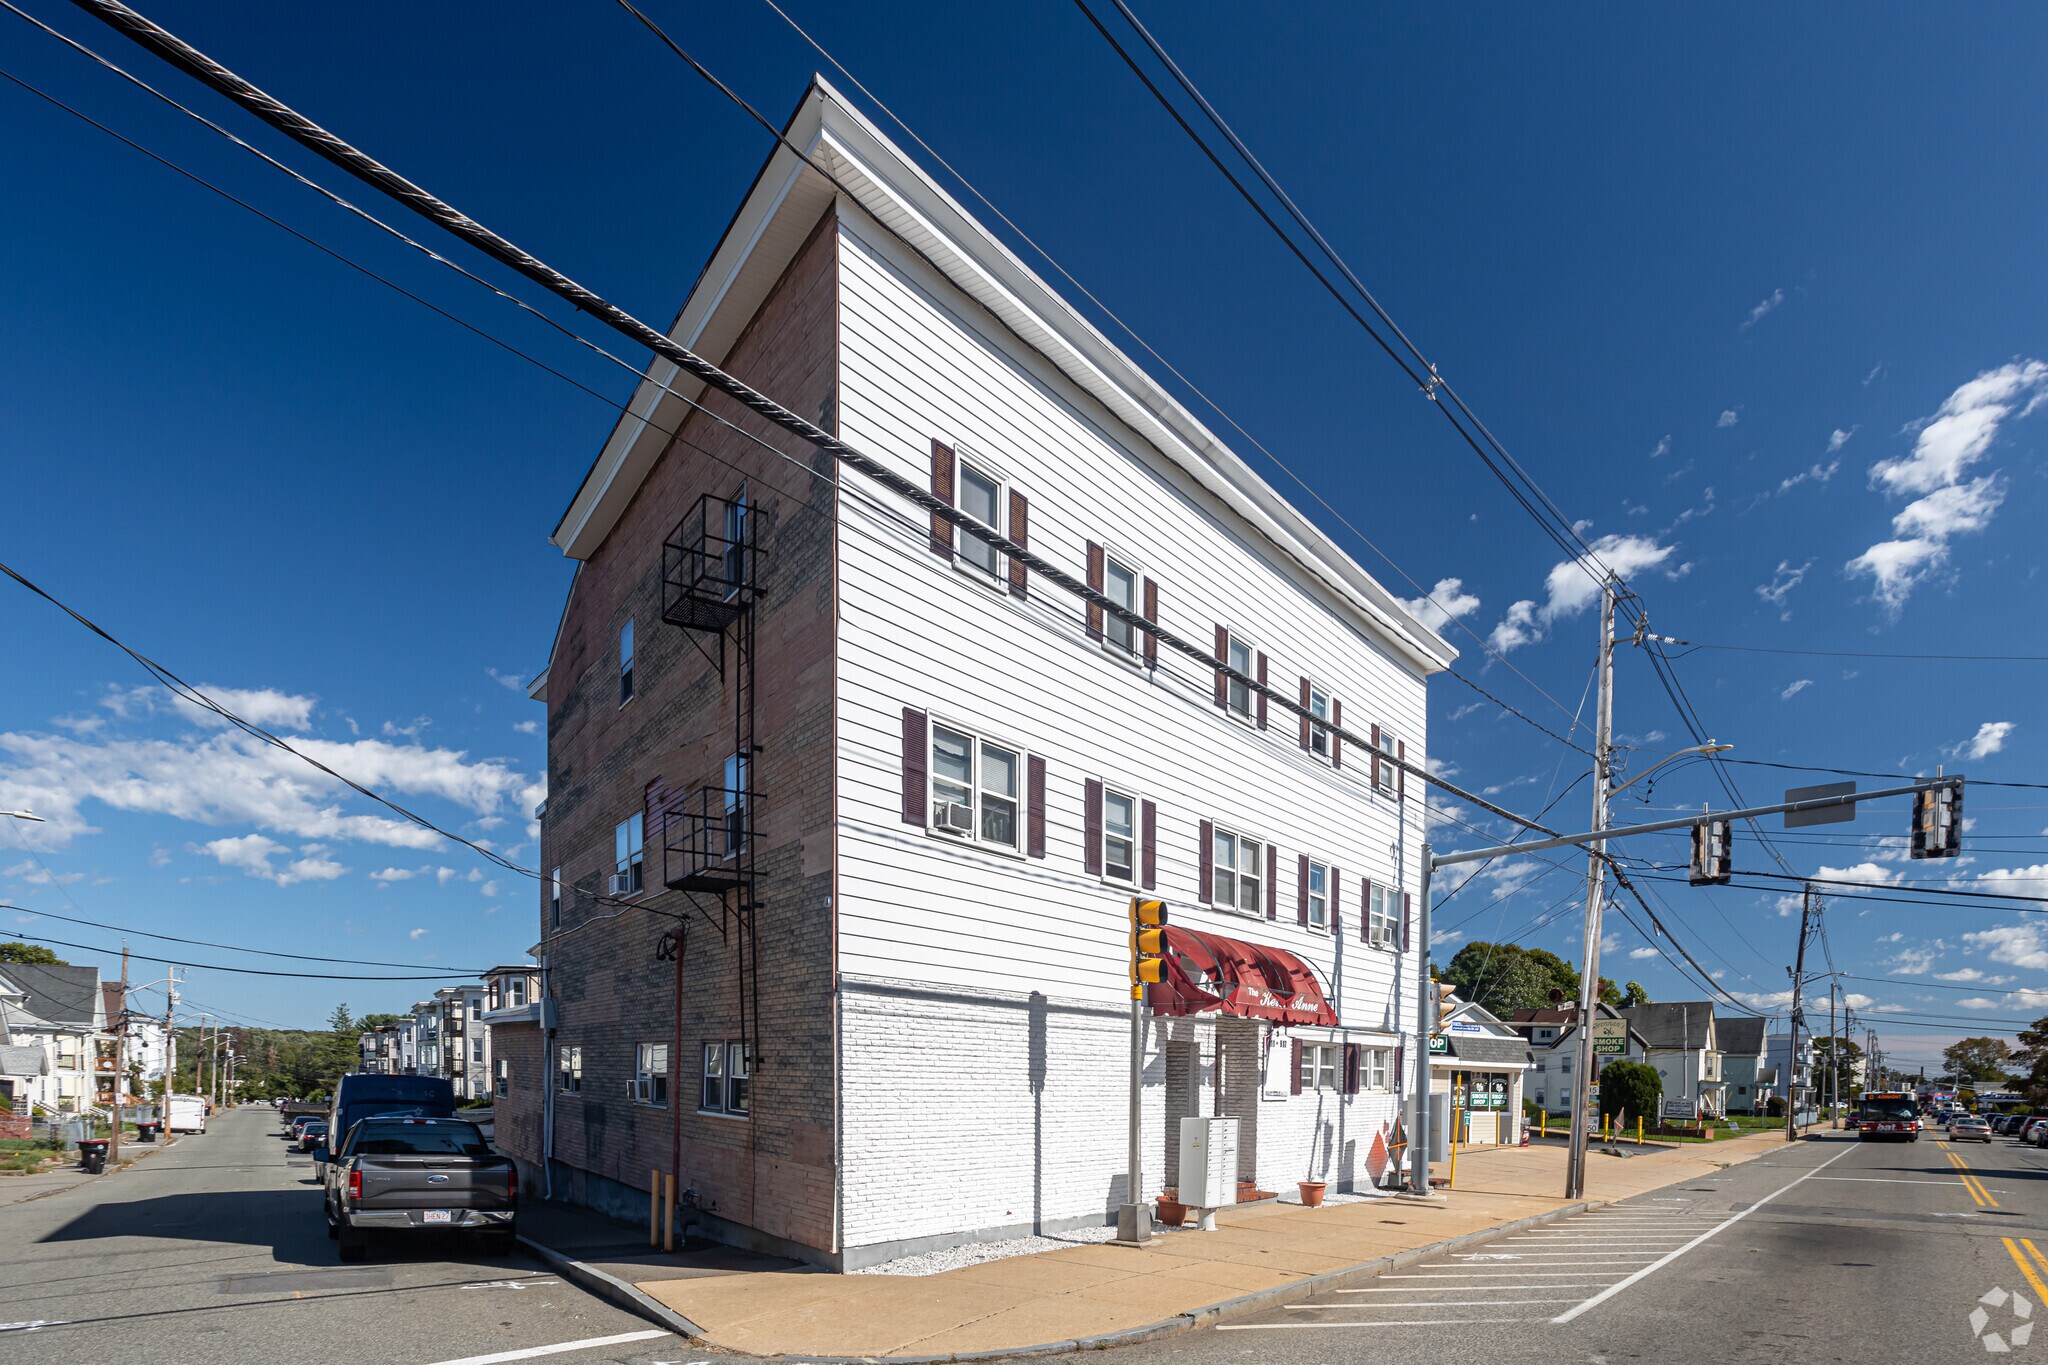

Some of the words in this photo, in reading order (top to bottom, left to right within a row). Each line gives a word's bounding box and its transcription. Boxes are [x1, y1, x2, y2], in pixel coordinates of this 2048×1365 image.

[1248, 987, 1259, 997] The
[1291, 995, 1319, 1011] Anne
[1430, 1038, 1445, 1048] OP
[1593, 1038, 1625, 1046] SMOKE
